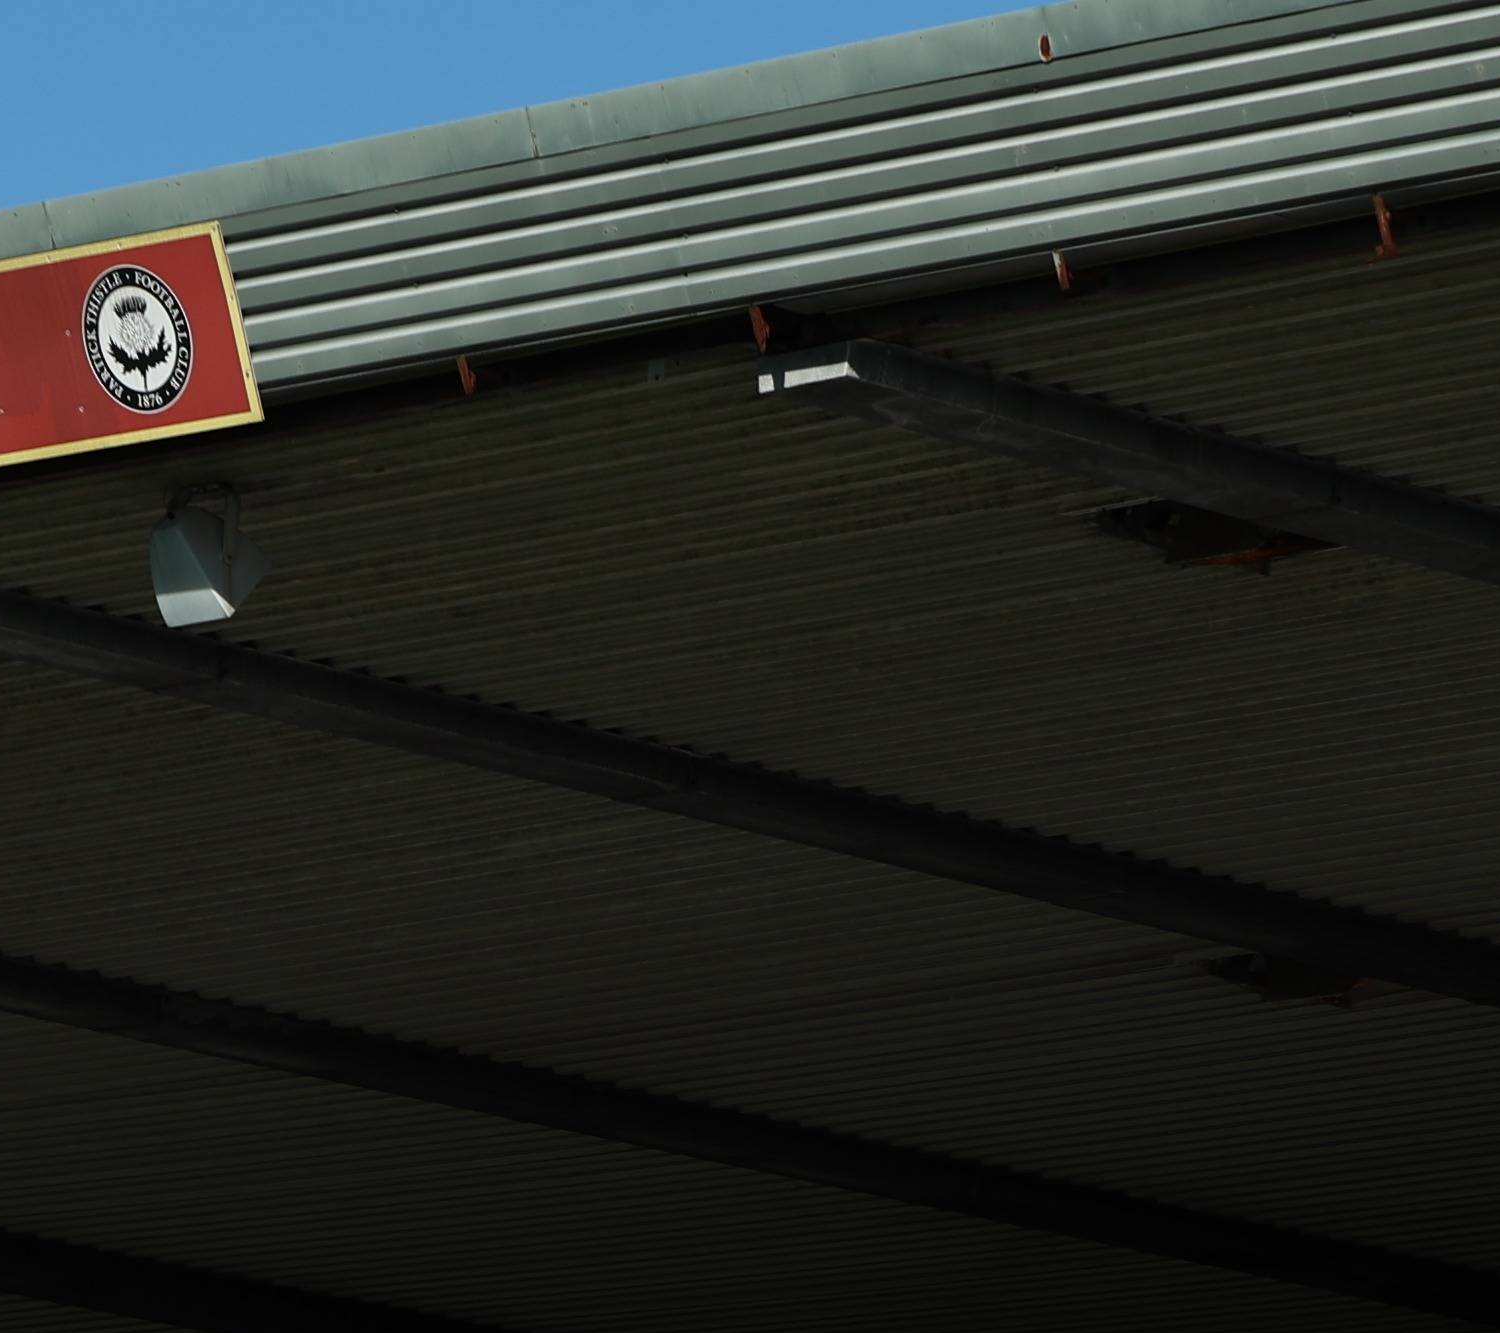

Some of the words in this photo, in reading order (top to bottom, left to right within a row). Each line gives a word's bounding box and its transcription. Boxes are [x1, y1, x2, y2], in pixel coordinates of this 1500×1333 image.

[86, 271, 123, 327] THISTLE
[133, 270, 189, 344] FOOTBALL
[85, 329, 124, 399] PARTICK
[169, 346, 190, 392] CLUB
[137, 392, 164, 409] 1876
